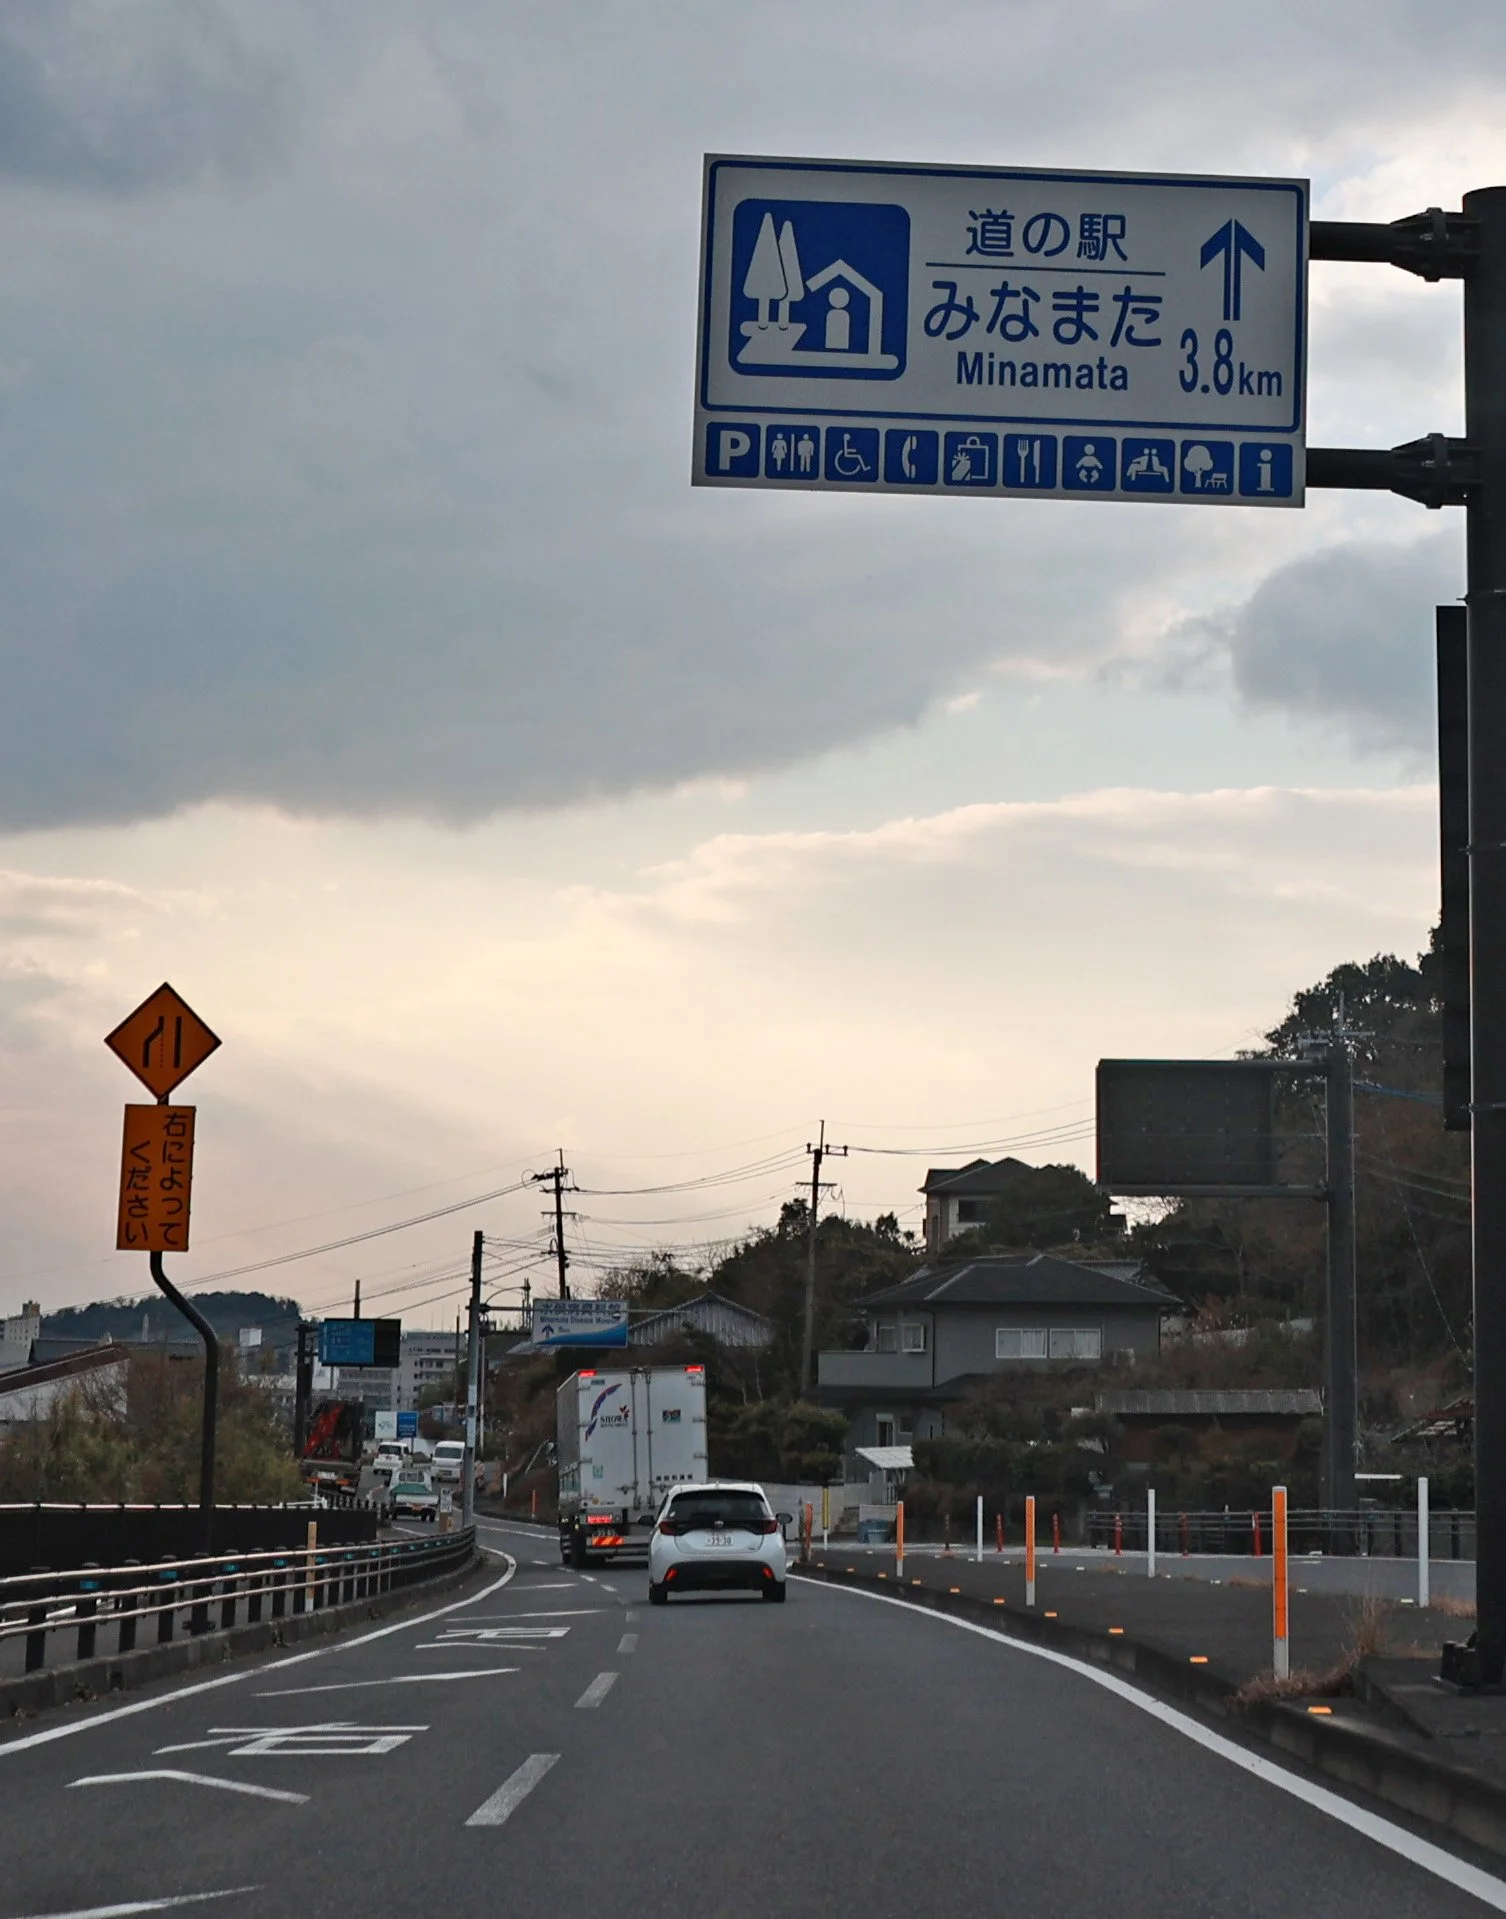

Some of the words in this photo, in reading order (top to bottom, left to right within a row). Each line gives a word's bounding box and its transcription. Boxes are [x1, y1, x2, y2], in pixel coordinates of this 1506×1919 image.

[966, 209, 1127, 261] 道の駅
[923, 280, 1163, 347] みなまた
[956, 351, 1129, 391] Minamata
[126, 1140, 152, 1244] ください
